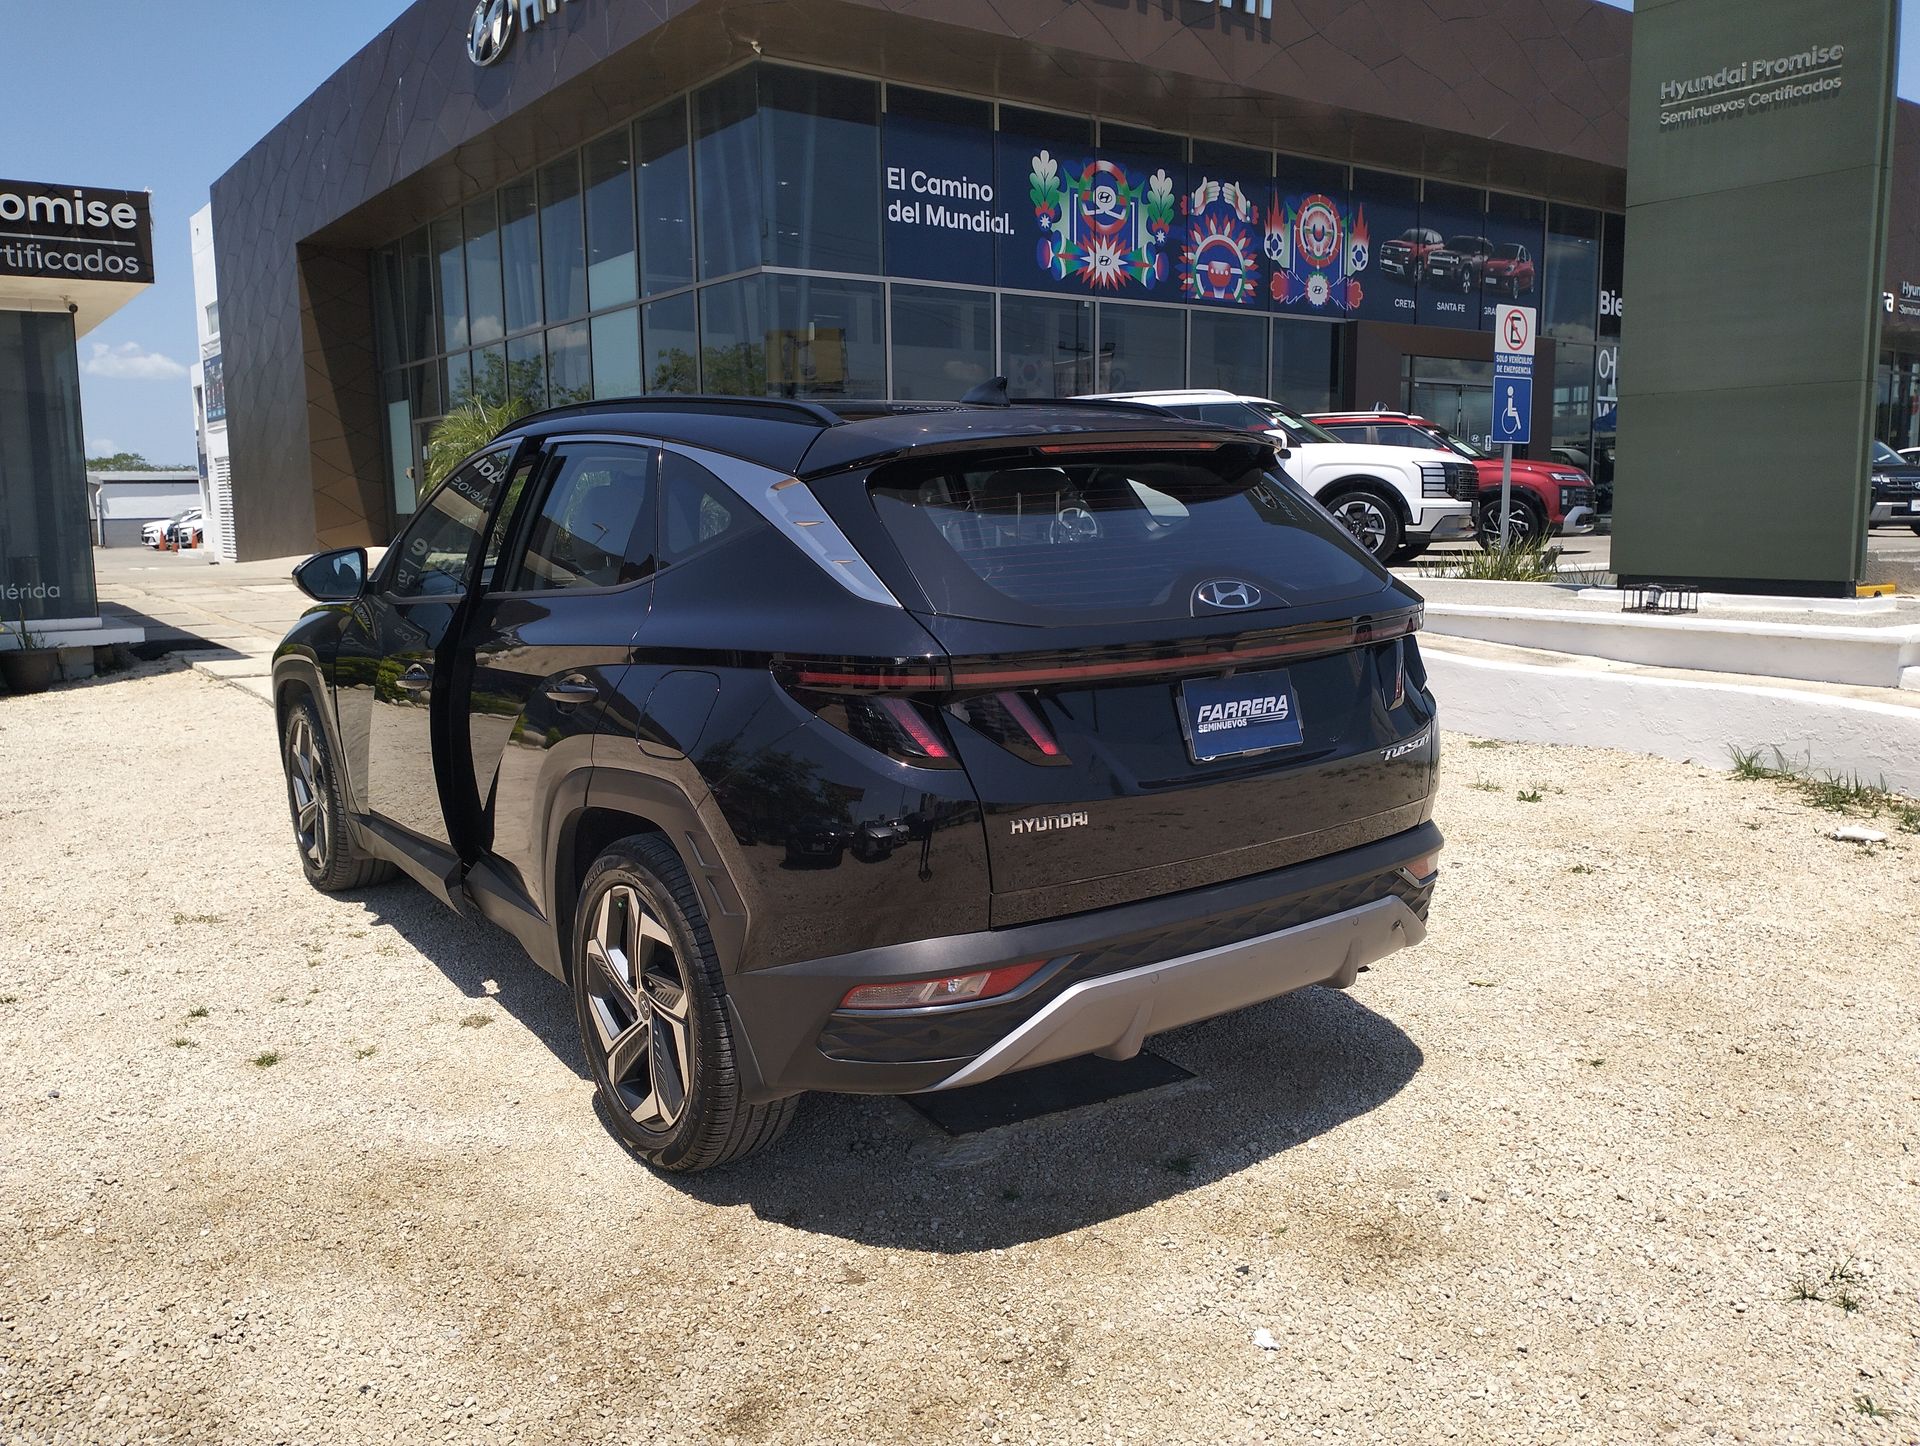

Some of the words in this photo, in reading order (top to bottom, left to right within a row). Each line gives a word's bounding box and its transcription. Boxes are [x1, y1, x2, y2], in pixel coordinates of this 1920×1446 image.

[1660, 62, 1747, 100] Hyundai
[1752, 45, 1845, 79] Promise
[1660, 98, 1746, 125] Seminuevos
[1748, 76, 1842, 106] Certificados
[887, 167, 905, 190] El
[911, 171, 993, 202] Camino
[888, 200, 919, 224] del
[926, 204, 1014, 235] Mundial.
[1394, 299, 1416, 309] CRETA
[1436, 301, 1457, 312] SANTA
[1458, 303, 1466, 312] FE
[1496, 354, 1508, 363] SOLO
[1496, 364, 1503, 373] DE
[1198, 695, 1288, 723] FARRERA
[1198, 719, 1247, 733] SEMINUEVOS
[1380, 734, 1429, 761] TUCSON
[1010, 811, 1088, 835] HYUNDAI
